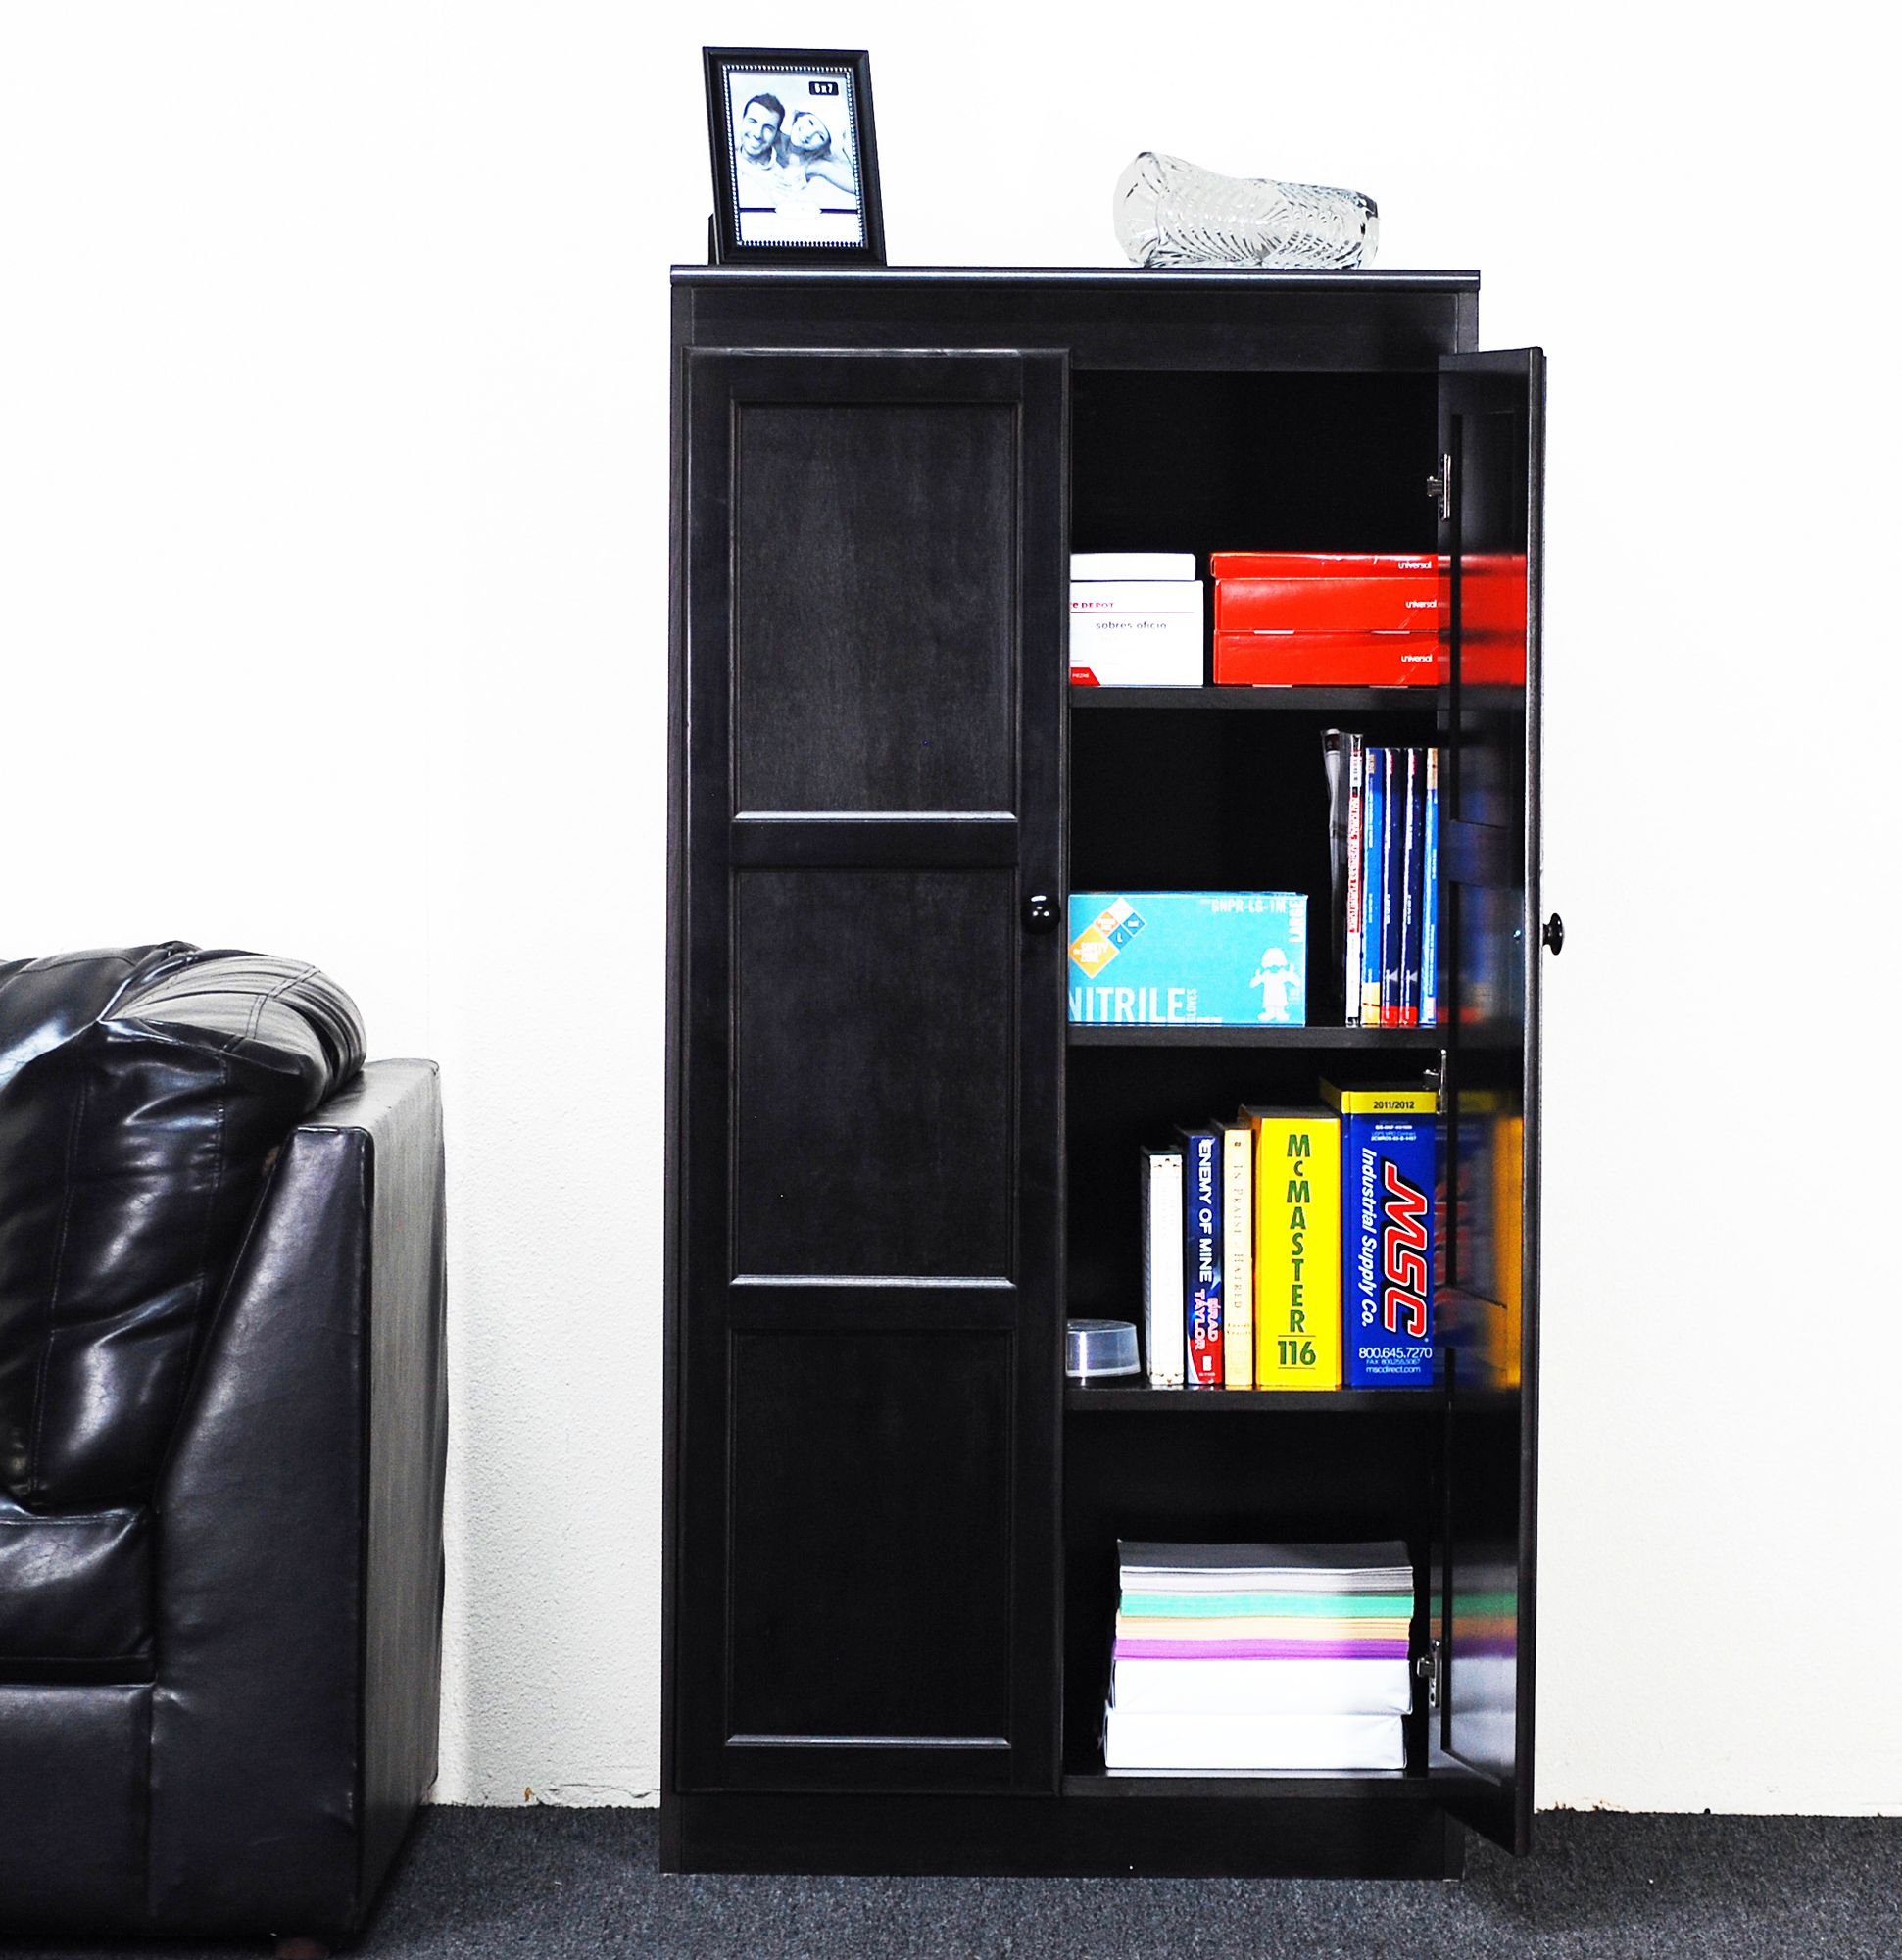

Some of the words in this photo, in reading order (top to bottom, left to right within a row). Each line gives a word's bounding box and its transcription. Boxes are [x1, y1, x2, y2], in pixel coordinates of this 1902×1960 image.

[1096, 620, 1133, 630] sobres
[1136, 619, 1167, 630] oficio
[1288, 900, 1304, 943] LARGE
[1068, 986, 1186, 1022] NITRILE
[1373, 1101, 1415, 1109] 2011/2012
[1197, 1137, 1214, 1205] ENEMY
[1361, 1148, 1378, 1234] Industrial
[1197, 1210, 1213, 1235] OF
[1198, 1239, 1213, 1283] MINE
[1358, 1235, 1378, 1296] Supply
[1384, 1161, 1428, 1338] MSC
[1193, 1288, 1206, 1350] TAYLOR
[1206, 1297, 1220, 1342] BRAD
[1361, 1298, 1378, 1328] Co.
[1277, 1340, 1316, 1366] 116
[1358, 1347, 1433, 1359] 800.645.7270
